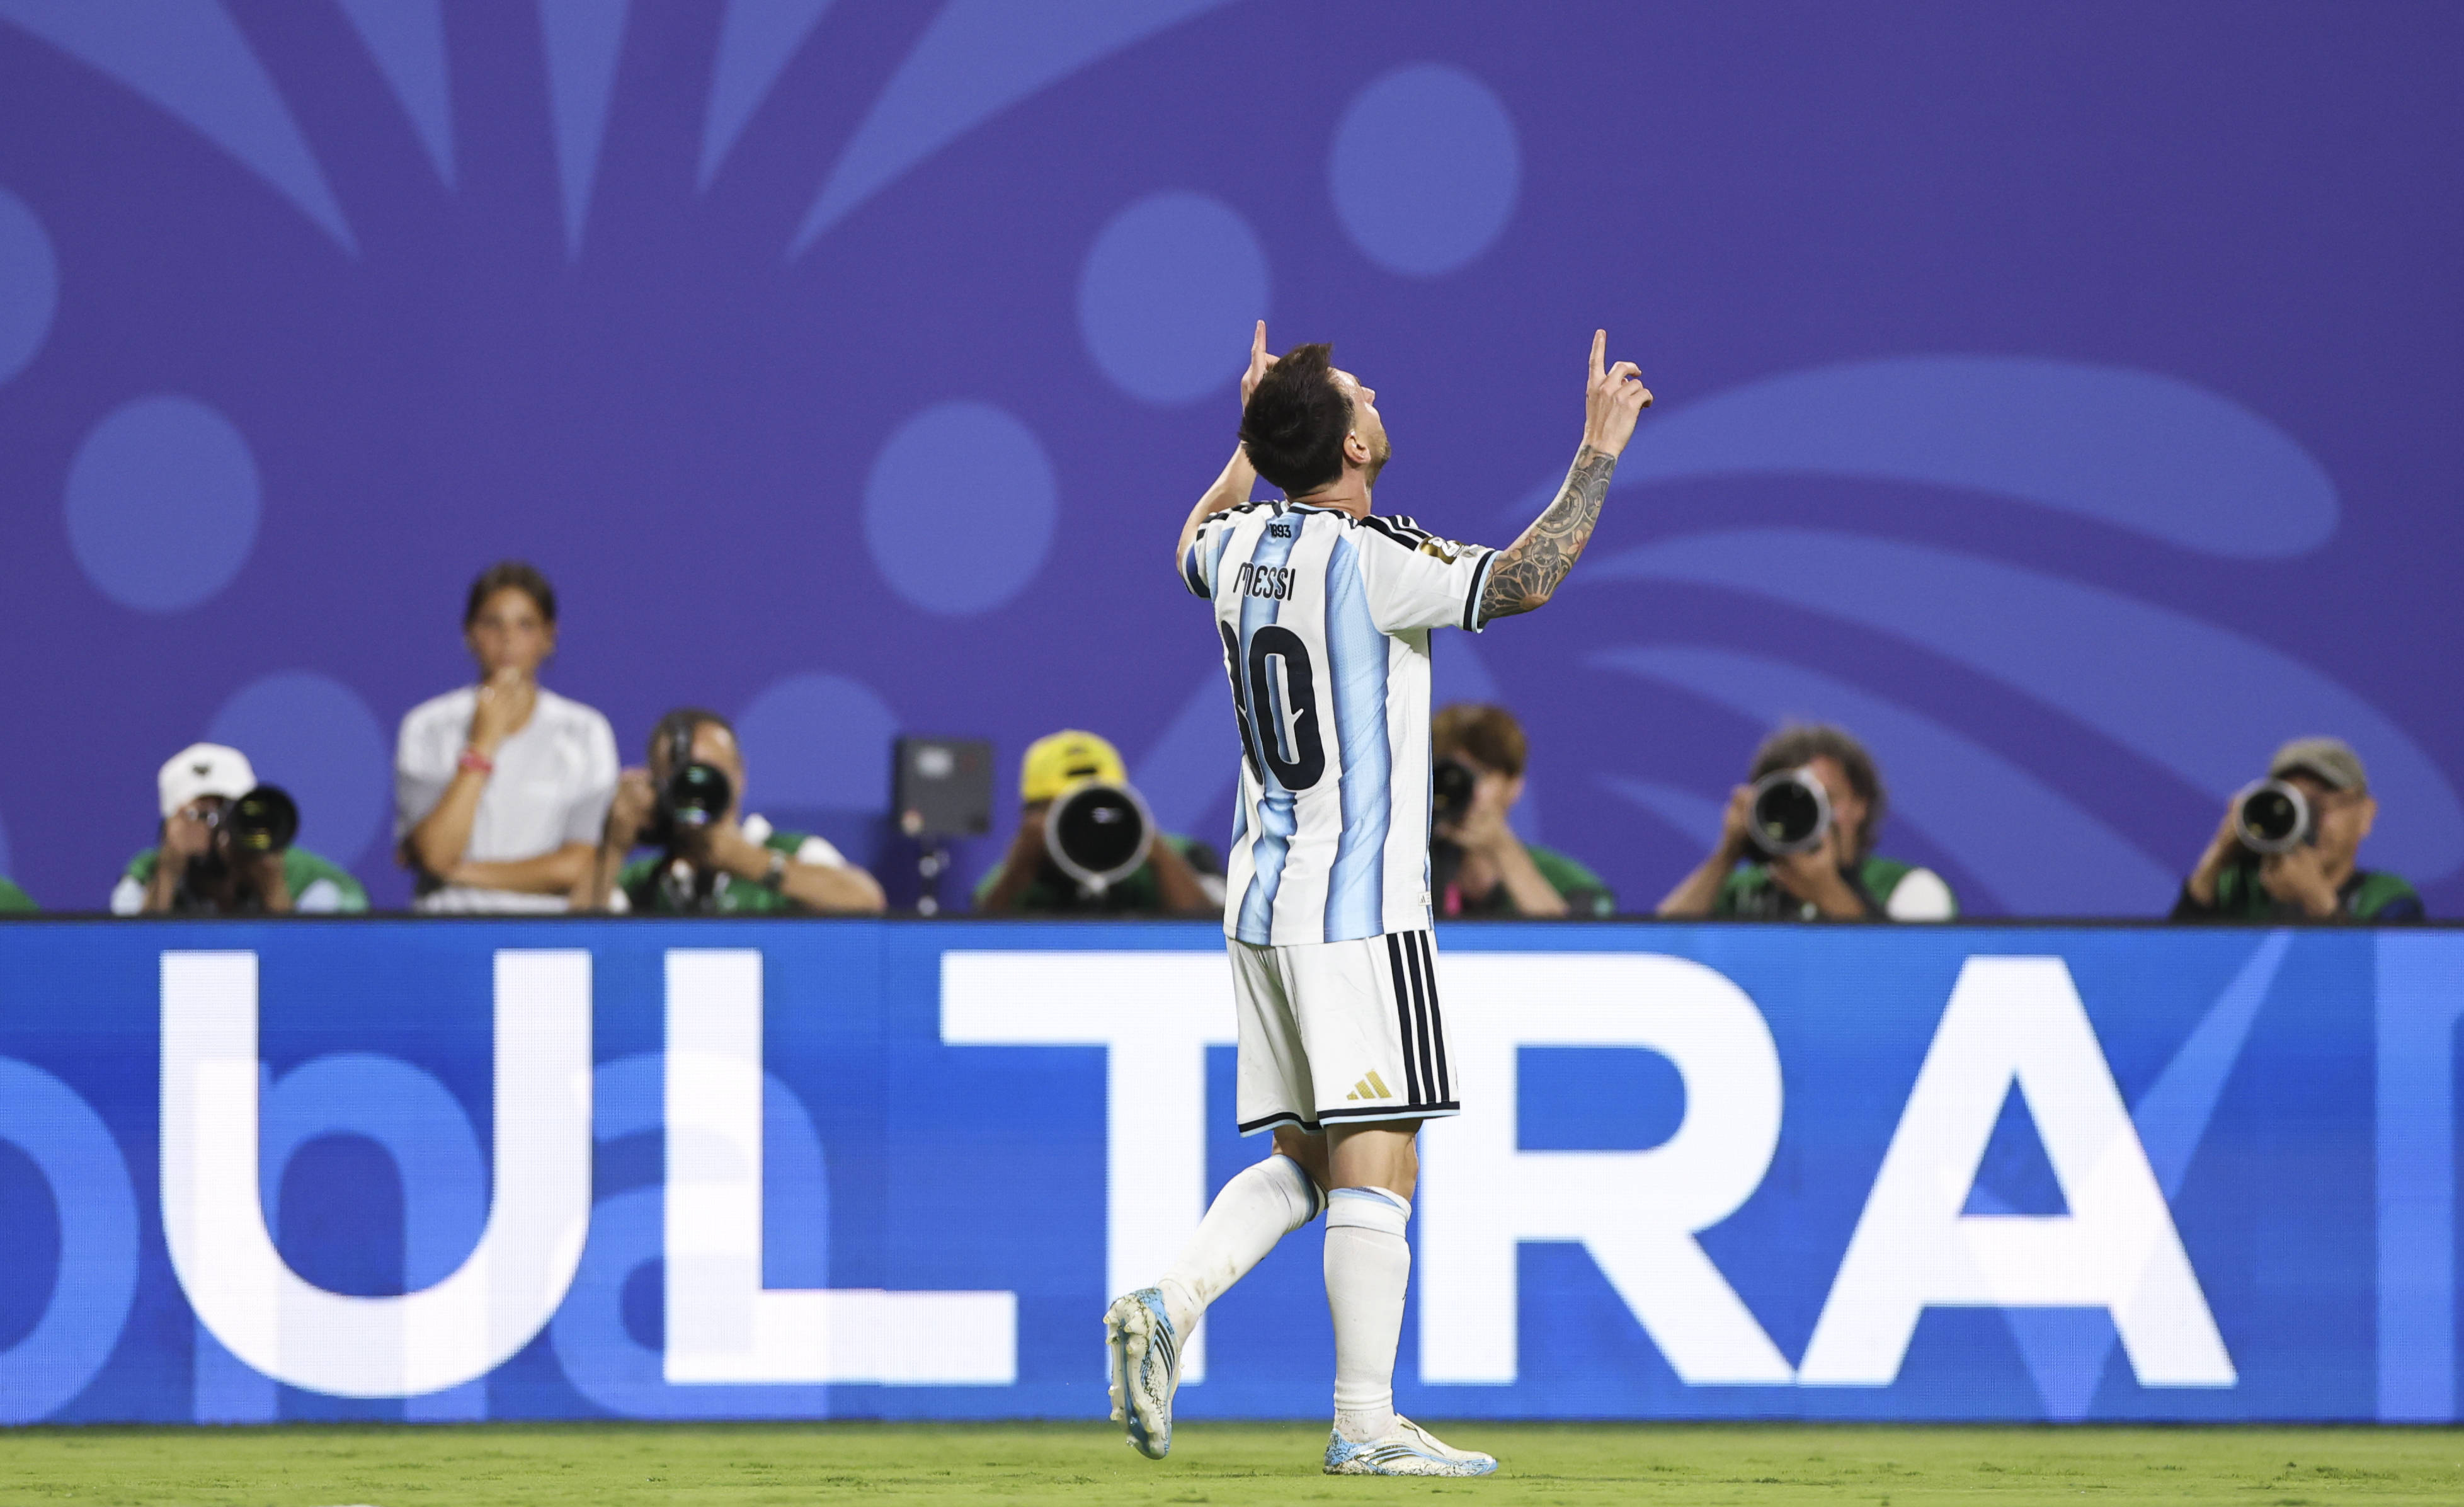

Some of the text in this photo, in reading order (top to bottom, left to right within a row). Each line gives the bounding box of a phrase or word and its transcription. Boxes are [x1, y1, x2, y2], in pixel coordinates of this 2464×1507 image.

[1233, 562, 1296, 601] MESSI
[1269, 523, 1292, 539] 1893
[1221, 620, 1325, 791] 10
[161, 949, 2237, 1397] ULTRA
